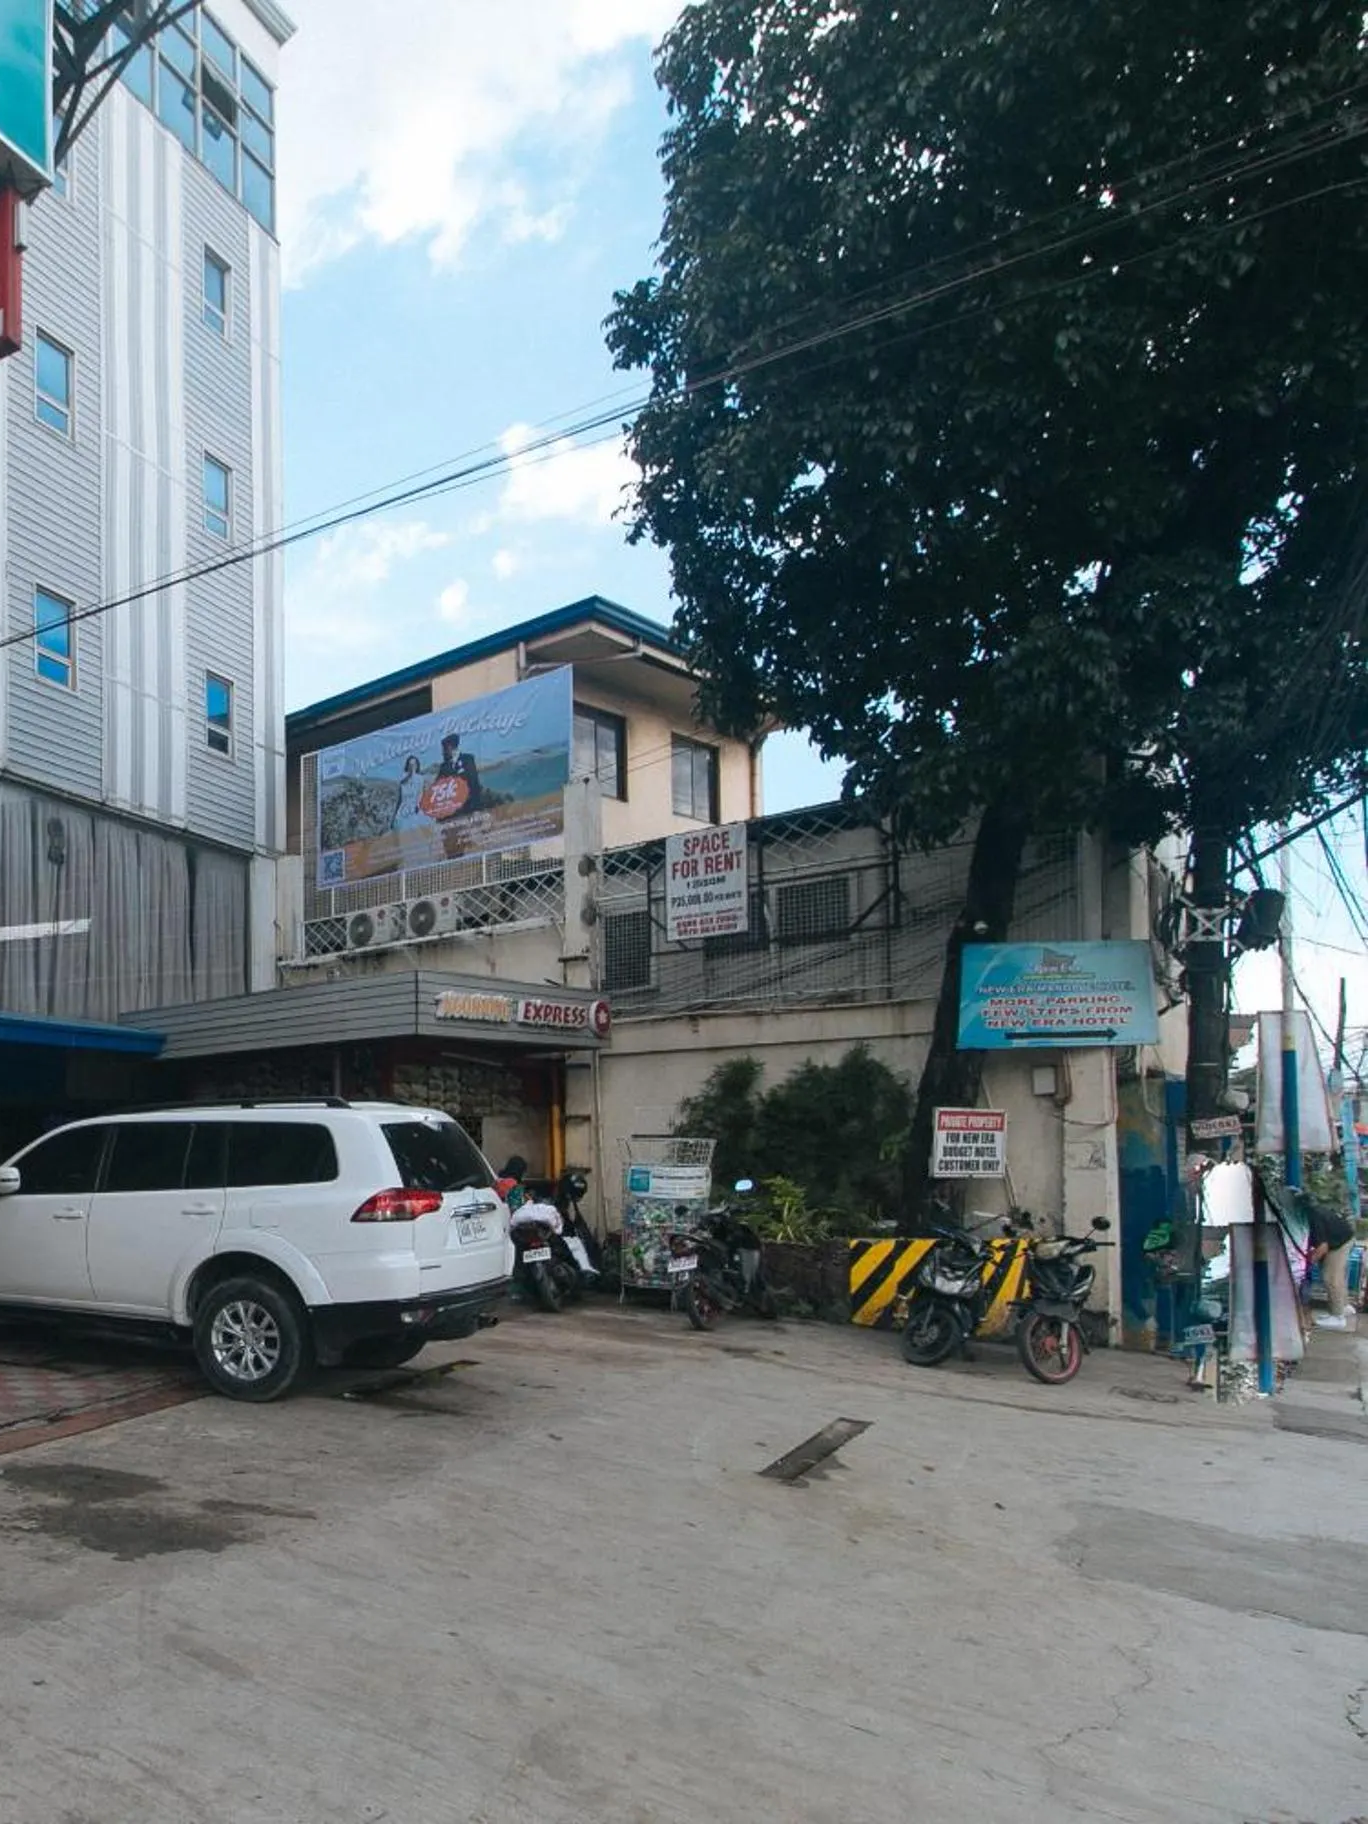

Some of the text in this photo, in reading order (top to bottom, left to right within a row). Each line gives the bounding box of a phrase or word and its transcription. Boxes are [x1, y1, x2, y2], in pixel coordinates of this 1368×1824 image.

[683, 831, 730, 857] SPACE
[672, 851, 743, 881] FOR RENT
[988, 995, 1120, 1007] MORE PARKING
[523, 1001, 586, 1025] EXPRESS
[981, 1006, 1132, 1017] FEW STEPS FROM
[986, 1017, 1128, 1028] NEW ERA HOTEL
[968, 1116, 1002, 1129] PROPERTY
[946, 1132, 960, 1144] FOR
[962, 1132, 980, 1144] NEW
[938, 1159, 1000, 1171] CUSTOMER ONLY
